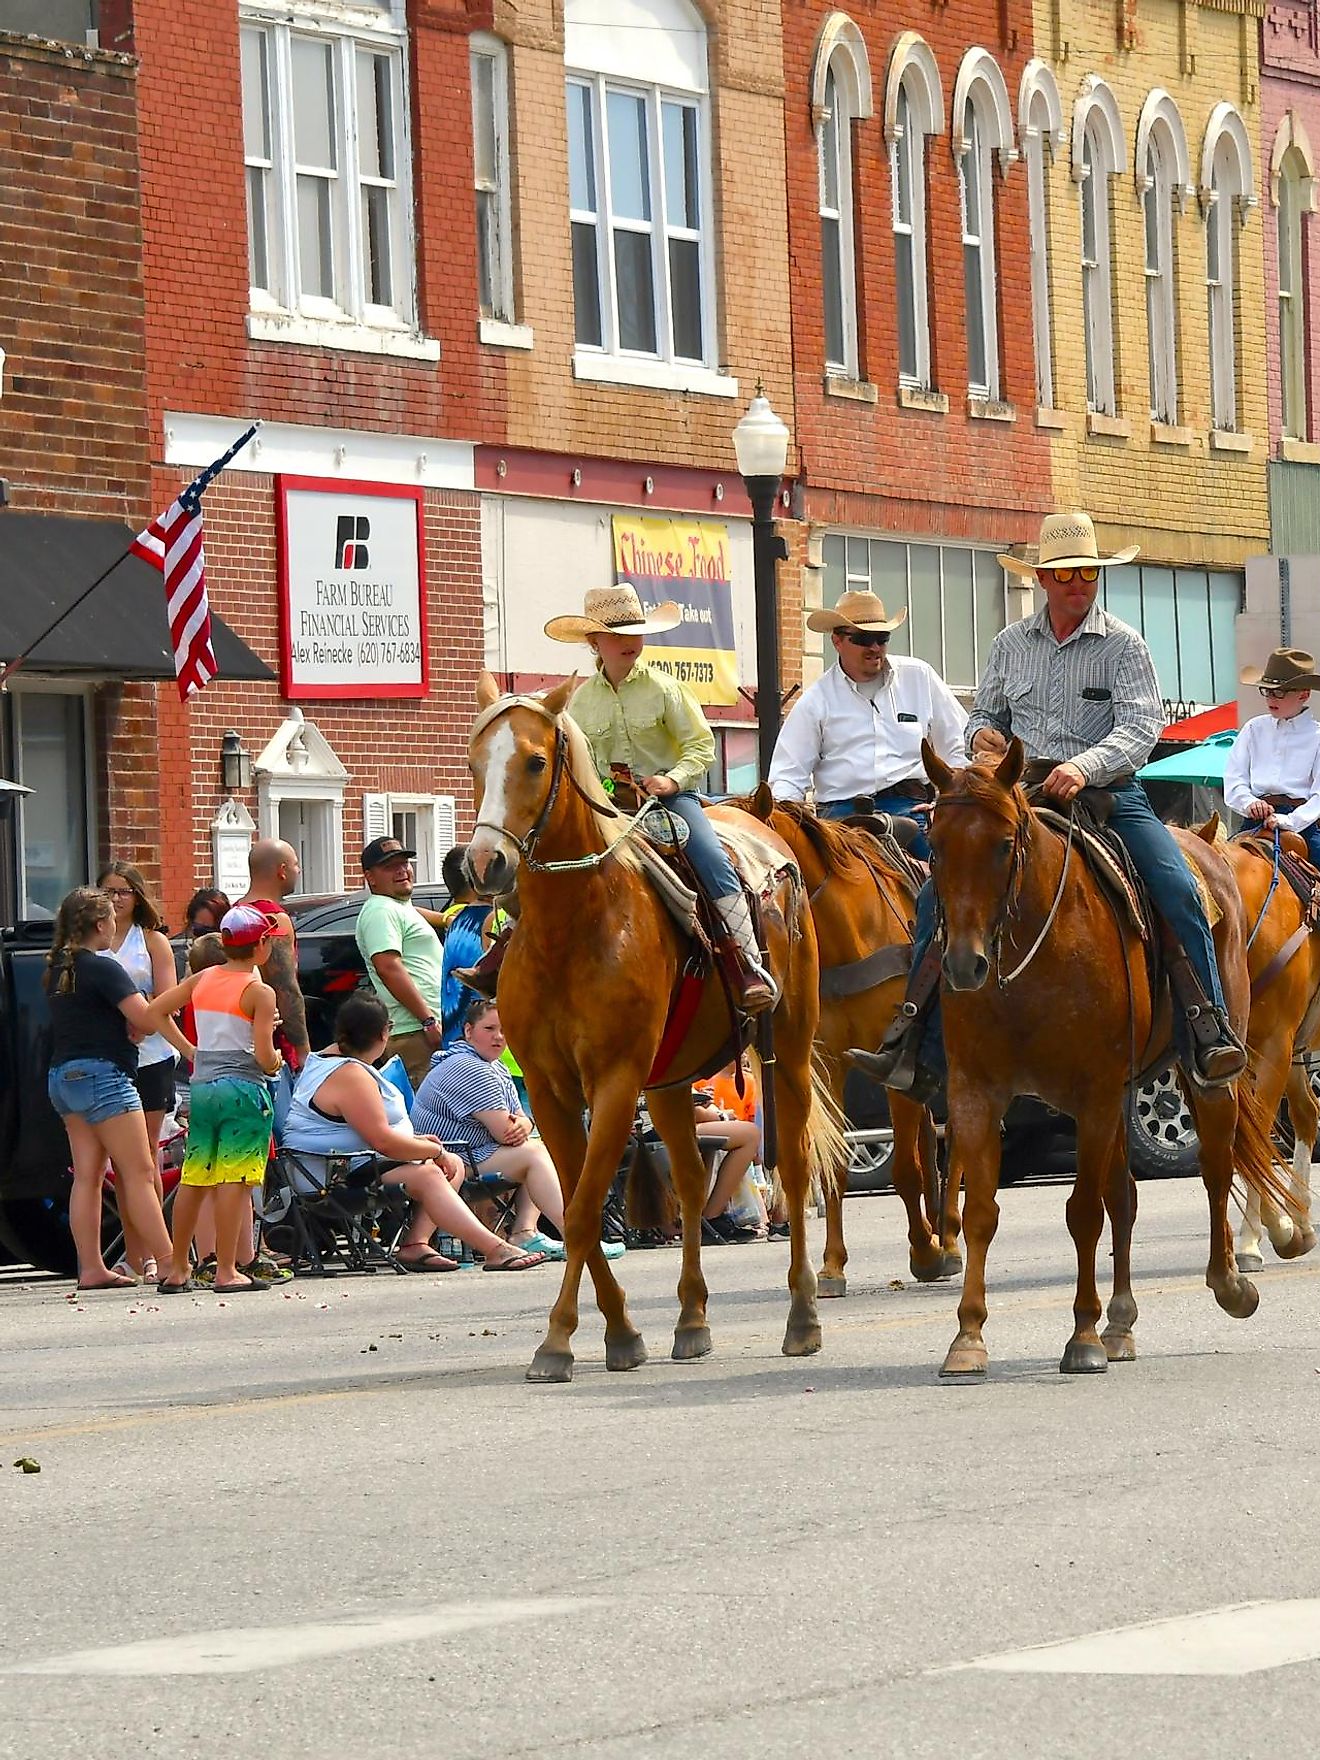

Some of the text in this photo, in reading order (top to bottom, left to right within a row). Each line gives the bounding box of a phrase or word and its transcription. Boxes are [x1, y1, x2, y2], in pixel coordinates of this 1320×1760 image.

[620, 531, 725, 581] Chinese Food
[316, 580, 393, 607] FARM BUREAU
[300, 611, 410, 637] FINANCIAL SERVICES
[291, 641, 420, 667] Alex Reinecke (620) 767-6834
[674, 661, 714, 683] 767-7373
